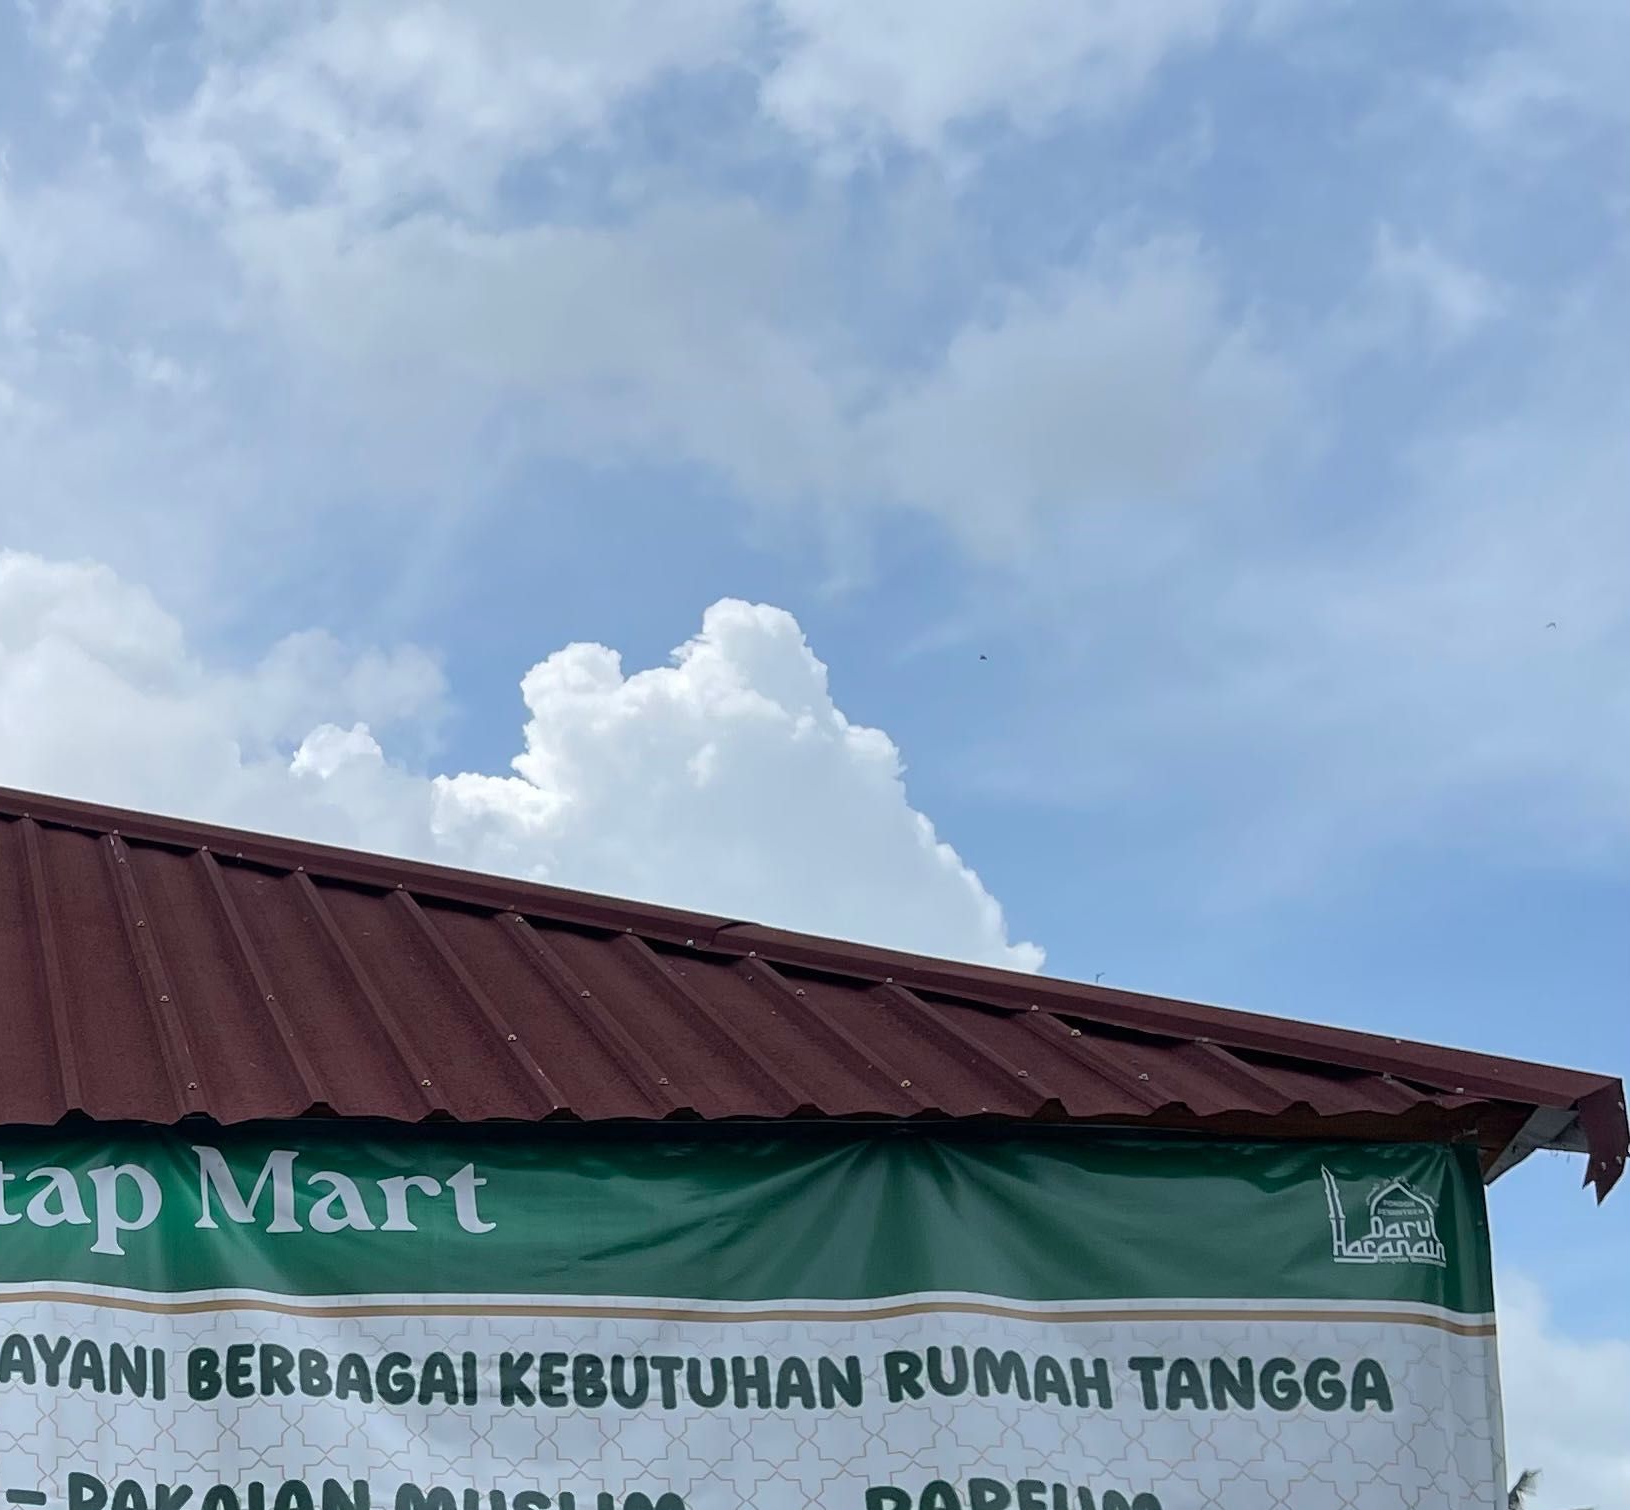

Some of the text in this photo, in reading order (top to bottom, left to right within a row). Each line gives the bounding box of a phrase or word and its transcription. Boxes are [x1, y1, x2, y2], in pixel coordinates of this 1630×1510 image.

[192, 1146, 496, 1233] Mart
[1360, 1216, 1440, 1241] Darul
[188, 1344, 477, 1406] BERBAGAI
[499, 1352, 863, 1409] KEBUTUHAN
[884, 1346, 1112, 1409] RUMAH
[1128, 1357, 1393, 1412] TANGGA
